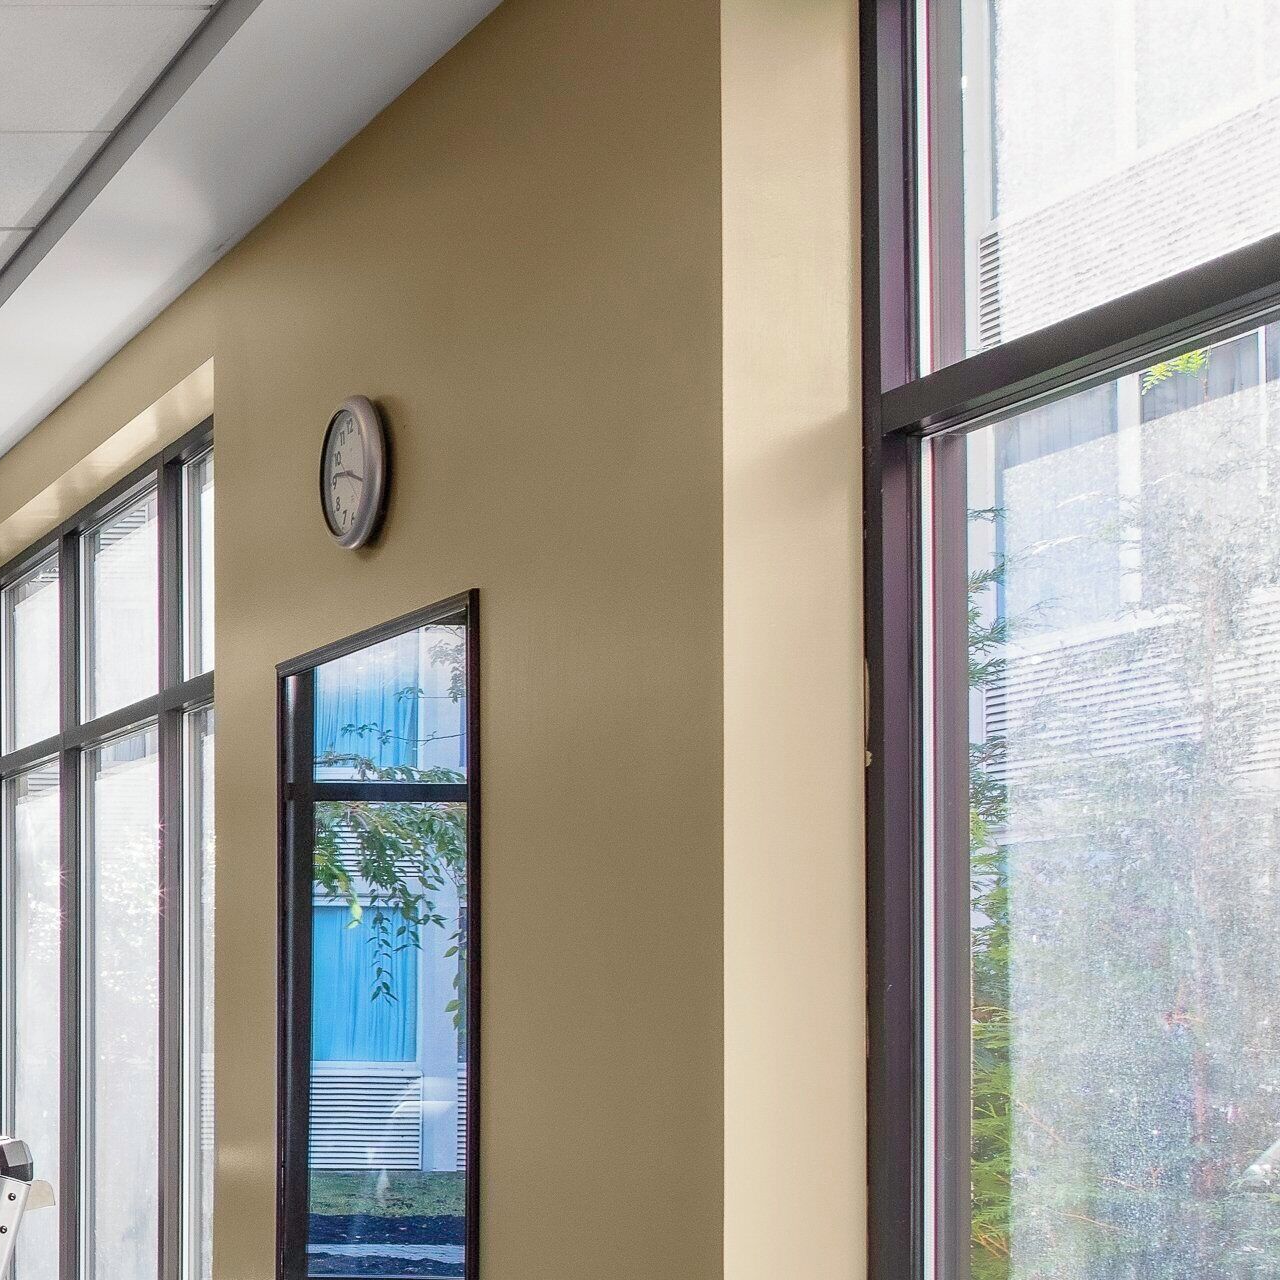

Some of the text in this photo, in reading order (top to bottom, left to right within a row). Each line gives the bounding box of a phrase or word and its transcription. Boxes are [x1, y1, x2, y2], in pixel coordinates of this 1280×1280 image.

[346, 418, 354, 435] 12
[340, 430, 346, 446] 11
[335, 451, 342, 468] 10
[335, 496, 341, 512] 8
[342, 509, 348, 526] 7
